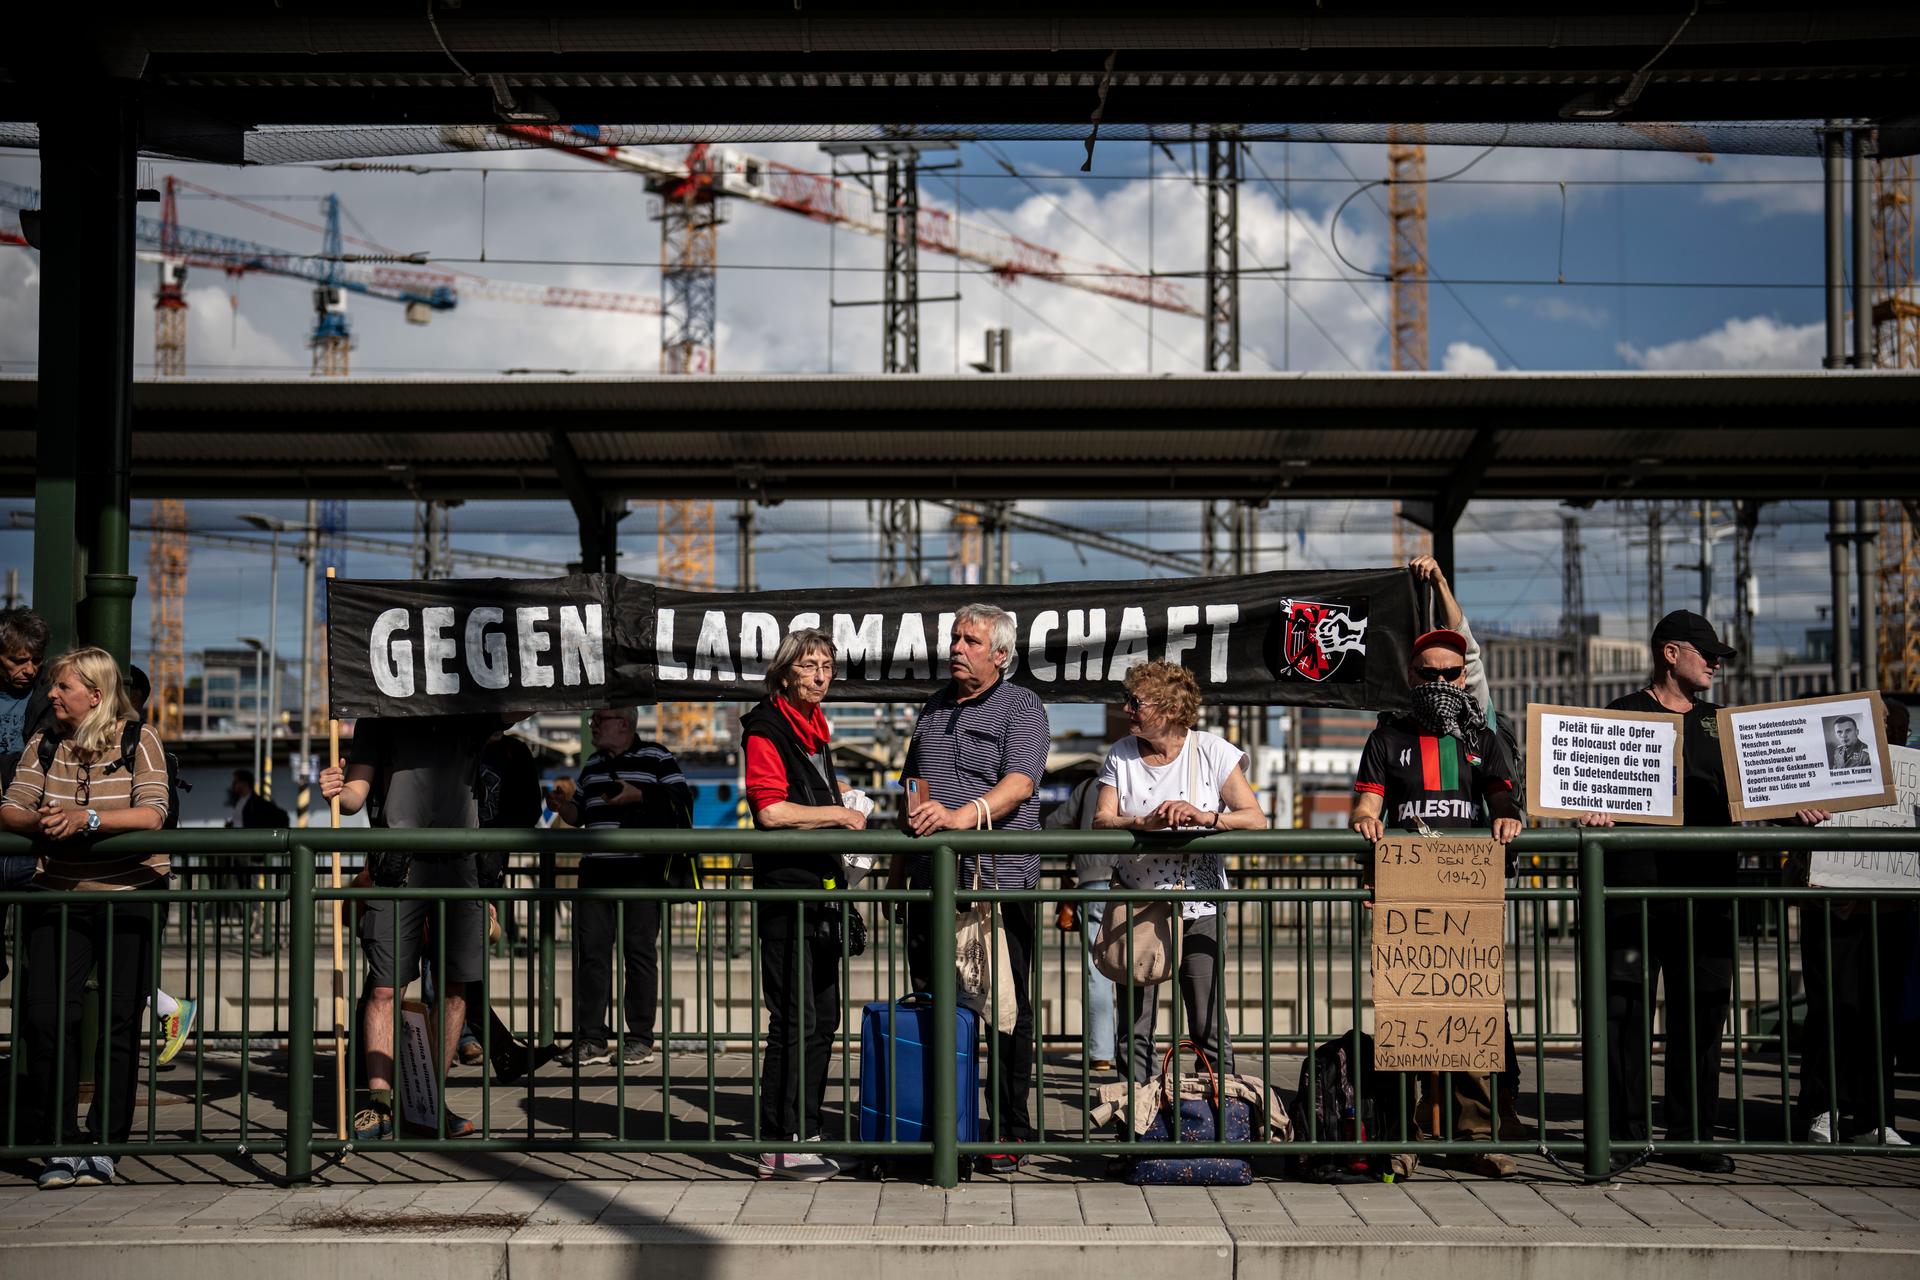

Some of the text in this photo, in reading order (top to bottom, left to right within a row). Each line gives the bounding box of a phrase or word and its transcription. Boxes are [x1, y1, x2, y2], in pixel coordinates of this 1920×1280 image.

[369, 603, 1240, 698] GEGEN LADMACHAFT
[1559, 720, 1655, 739] Pietät für alle Opfer
[1738, 718, 1807, 732] Dieser Sudetendeutsche
[1739, 727, 1804, 741] liess Hunderttausende
[1552, 735, 1662, 754] des Holocaust oder nur
[1741, 740, 1770, 749] Menschen
[1553, 749, 1660, 768] für diejenigen die von
[1795, 753, 1807, 761] und
[1553, 764, 1660, 783] den Sudetendeutschen
[1745, 768, 1767, 776] Ungarn
[1807, 770, 1817, 778] 93
[1560, 779, 1652, 797] in die gaskammern
[1748, 786, 1767, 794] Kinder
[1780, 782, 1798, 790] Lidice
[1799, 780, 1811, 788] und
[1561, 796, 1651, 812] geschickt wurden ?
[1425, 841, 1494, 856] VÝZNAMNÝ
[1437, 857, 1464, 866] DEN
[1437, 868, 1487, 890] (1942)
[1386, 908, 1471, 936] DEN
[1376, 938, 1501, 970] NÁRODNÍHO
[1384, 972, 1501, 998] VZDORU
[1441, 1053, 1471, 1068] DEN
